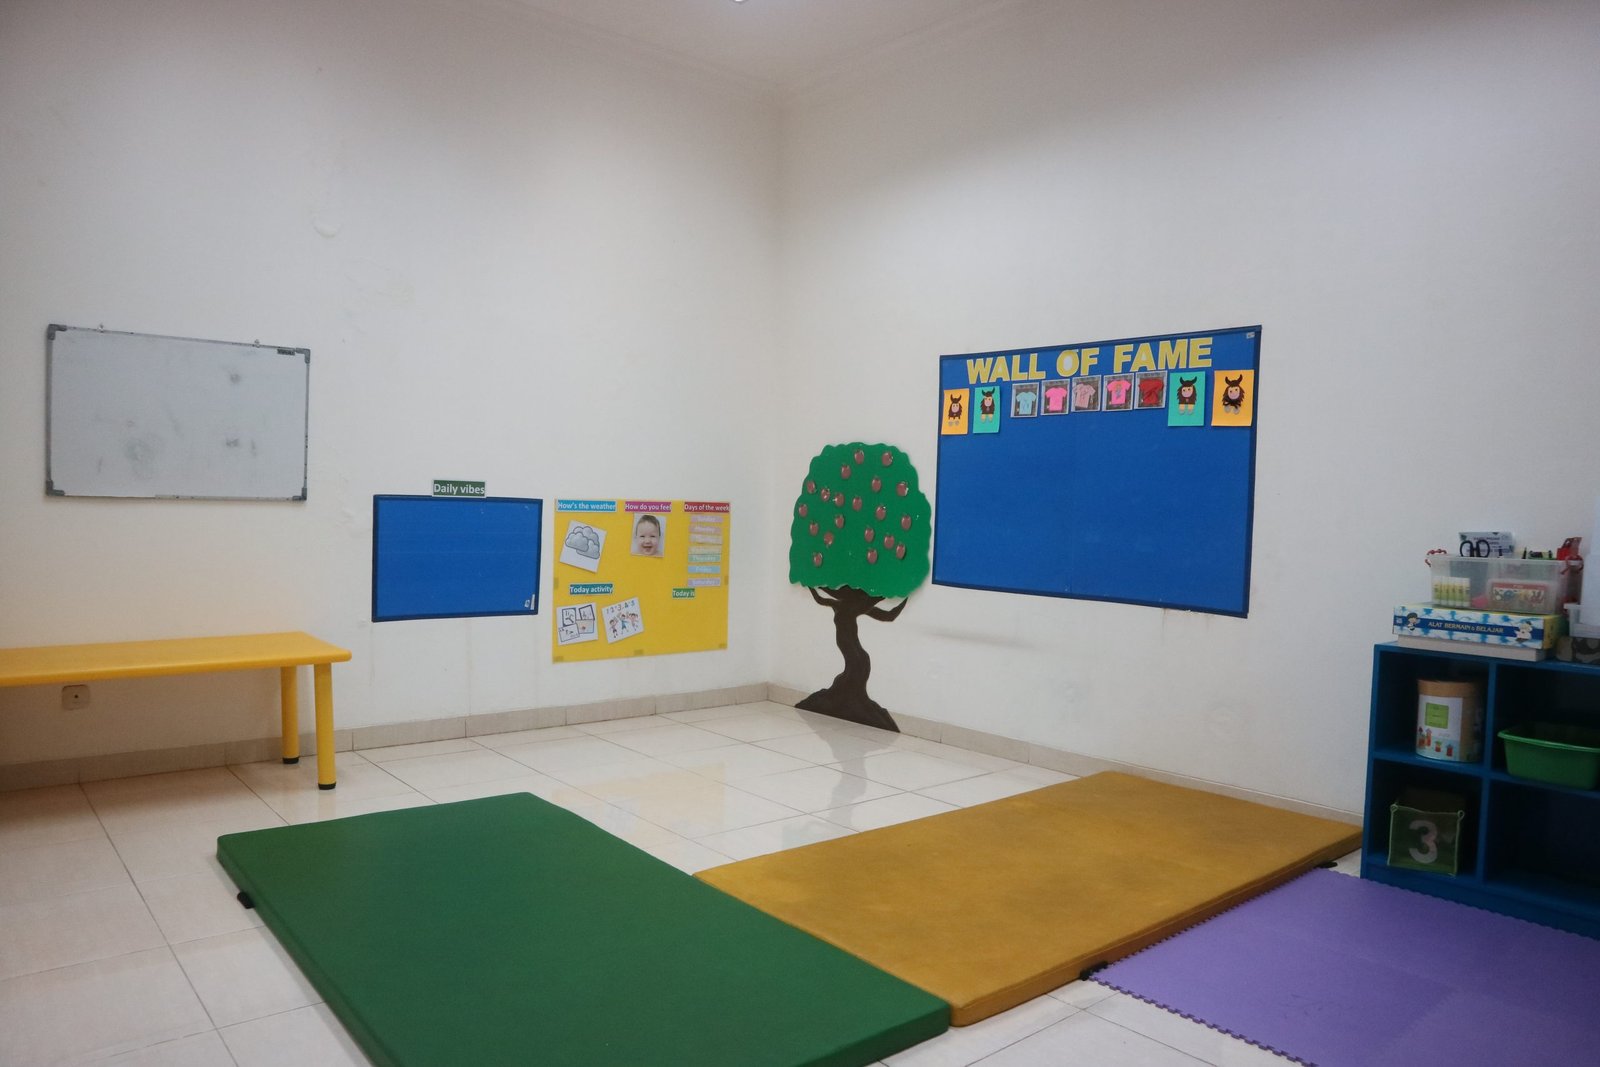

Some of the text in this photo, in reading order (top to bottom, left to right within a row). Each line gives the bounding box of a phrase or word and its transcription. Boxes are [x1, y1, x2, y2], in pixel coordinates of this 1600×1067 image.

[966, 337, 1213, 385] WALL OF FAME
[433, 483, 485, 495] Daily vibes
[558, 502, 577, 510] How's
[625, 502, 639, 510] How
[640, 502, 648, 510] do
[570, 585, 613, 595] Today activity
[672, 590, 690, 598] Today
[1408, 819, 1439, 864] 3
